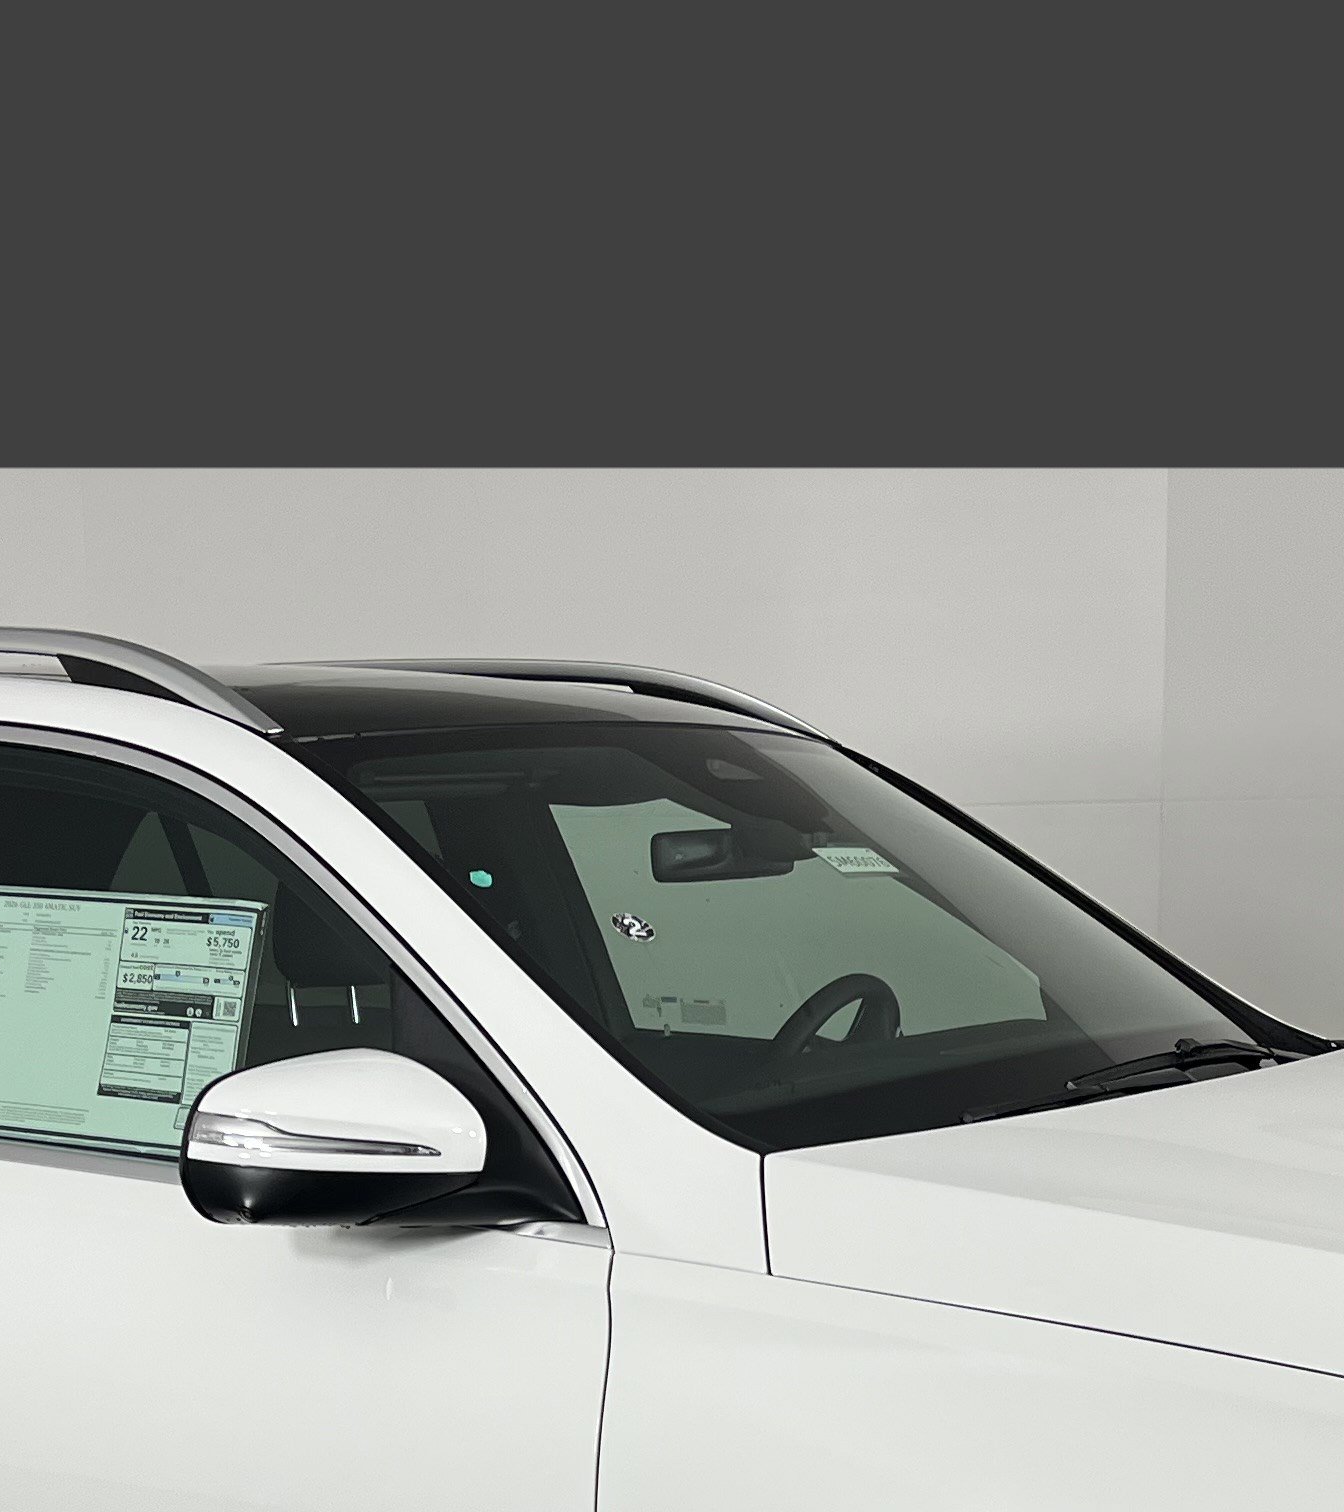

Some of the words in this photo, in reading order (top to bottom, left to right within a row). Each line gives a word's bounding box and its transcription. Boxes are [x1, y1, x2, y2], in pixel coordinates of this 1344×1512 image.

[131, 925, 148, 941] 22
[206, 936, 240, 949] $5,750
[122, 972, 153, 984] $2,850
